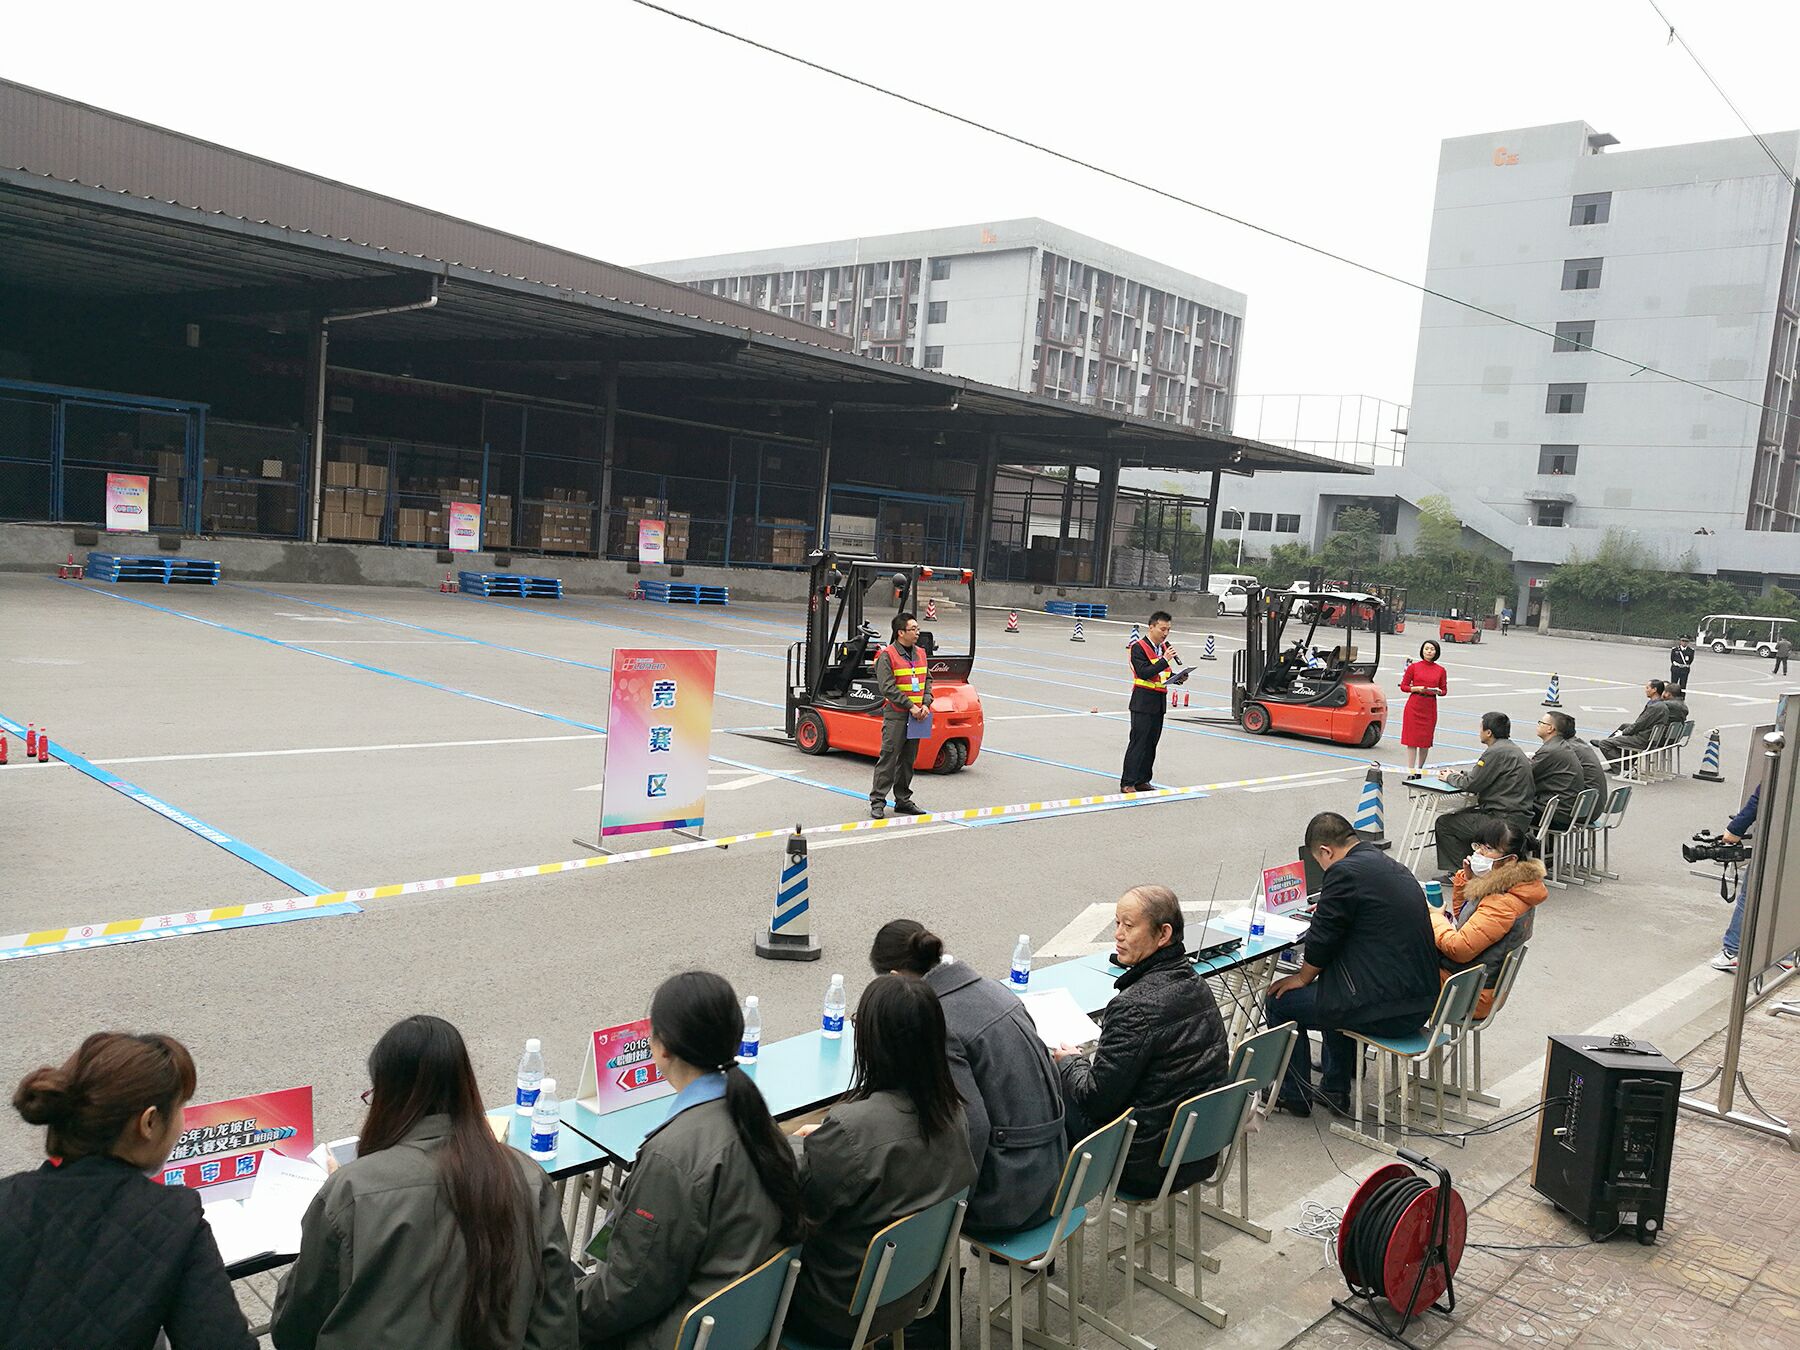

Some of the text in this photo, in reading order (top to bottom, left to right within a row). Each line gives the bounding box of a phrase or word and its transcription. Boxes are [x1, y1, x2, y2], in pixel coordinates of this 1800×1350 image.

[850, 687, 875, 700] Linde
[1292, 686, 1316, 696] Linde
[647, 680, 676, 798] 竞赛区
[159, 899, 297, 928] 注意 安全
[164, 1154, 257, 1186] 监审席
